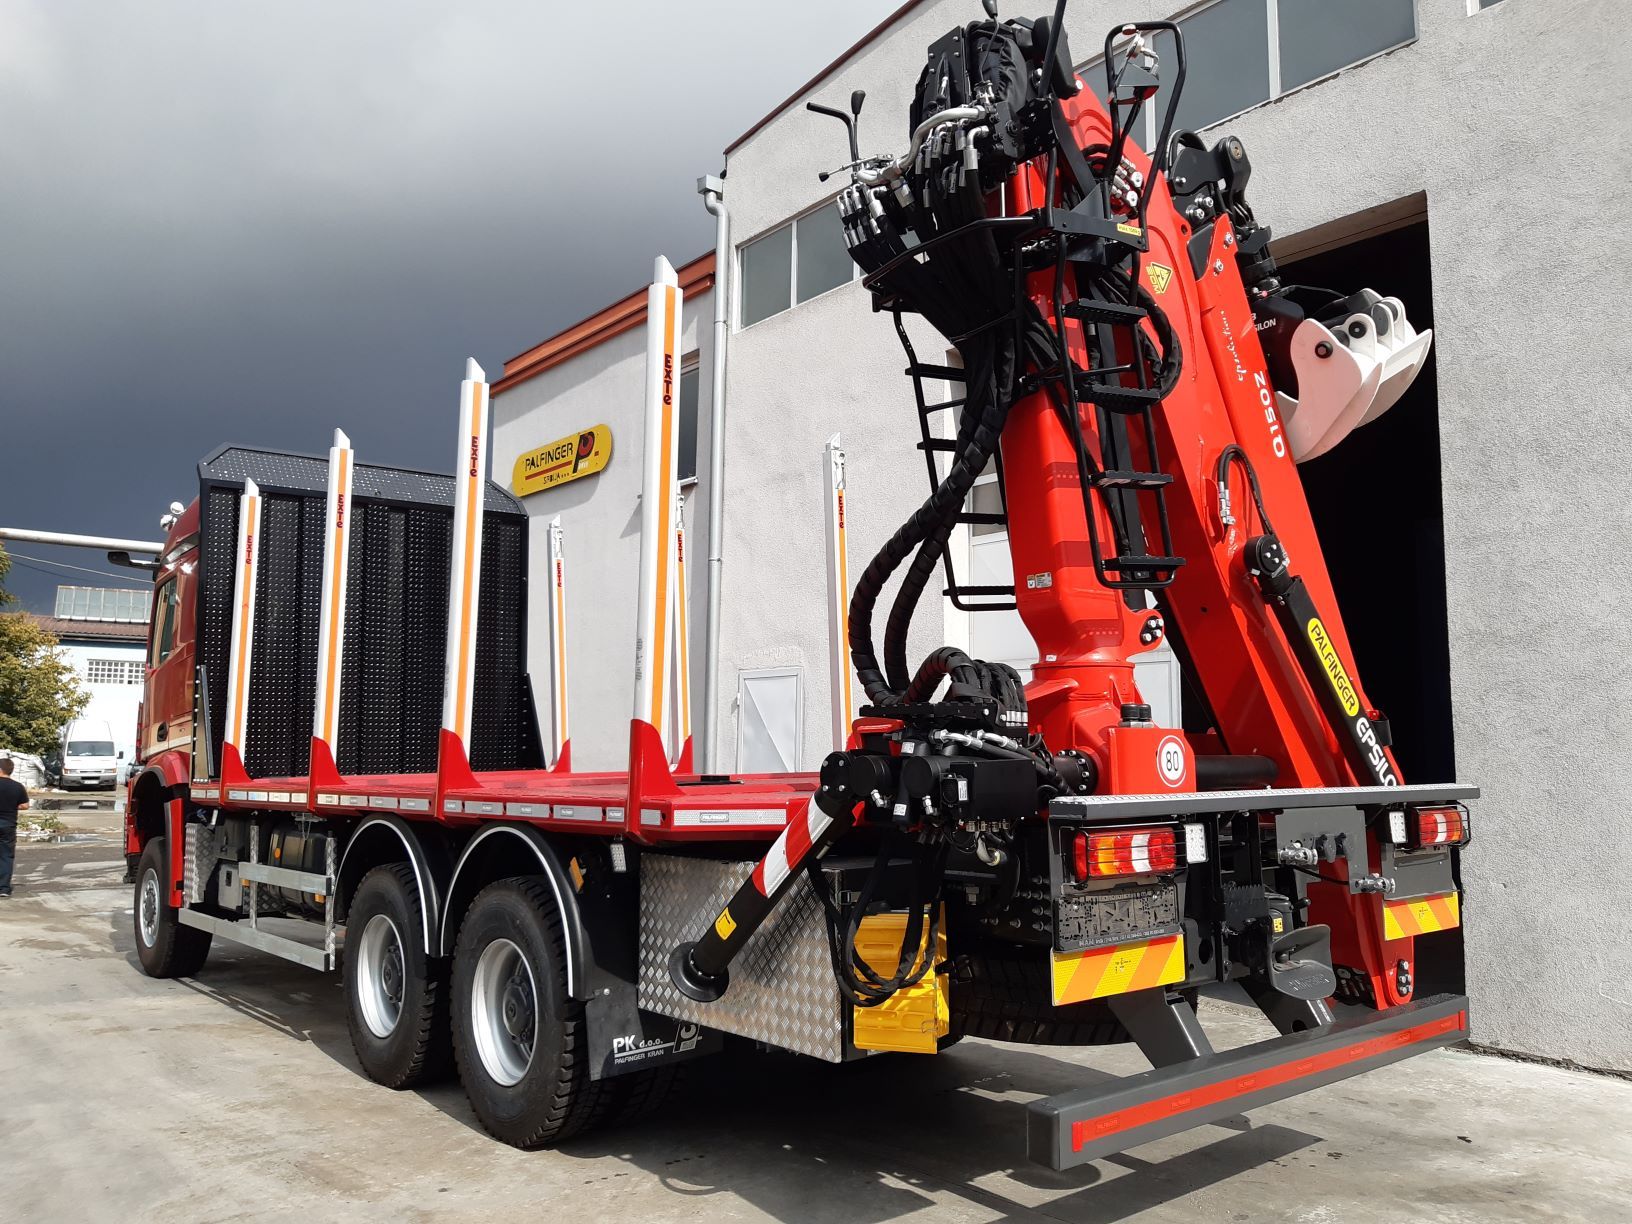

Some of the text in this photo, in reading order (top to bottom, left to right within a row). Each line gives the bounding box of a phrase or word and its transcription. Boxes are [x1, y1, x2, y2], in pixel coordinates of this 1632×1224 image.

[1254, 318, 1277, 332] ILON
[1254, 371, 1285, 458] Q150Z
[525, 442, 573, 471] PALFINGER
[1311, 624, 1357, 711] PALFINGER
[1166, 751, 1179, 771] 80
[1356, 717, 1397, 786] EPSILO
[613, 1035, 636, 1053] PK
[639, 1039, 664, 1048] d.o.o.
[614, 1049, 664, 1064] PALFINGER KRAN
